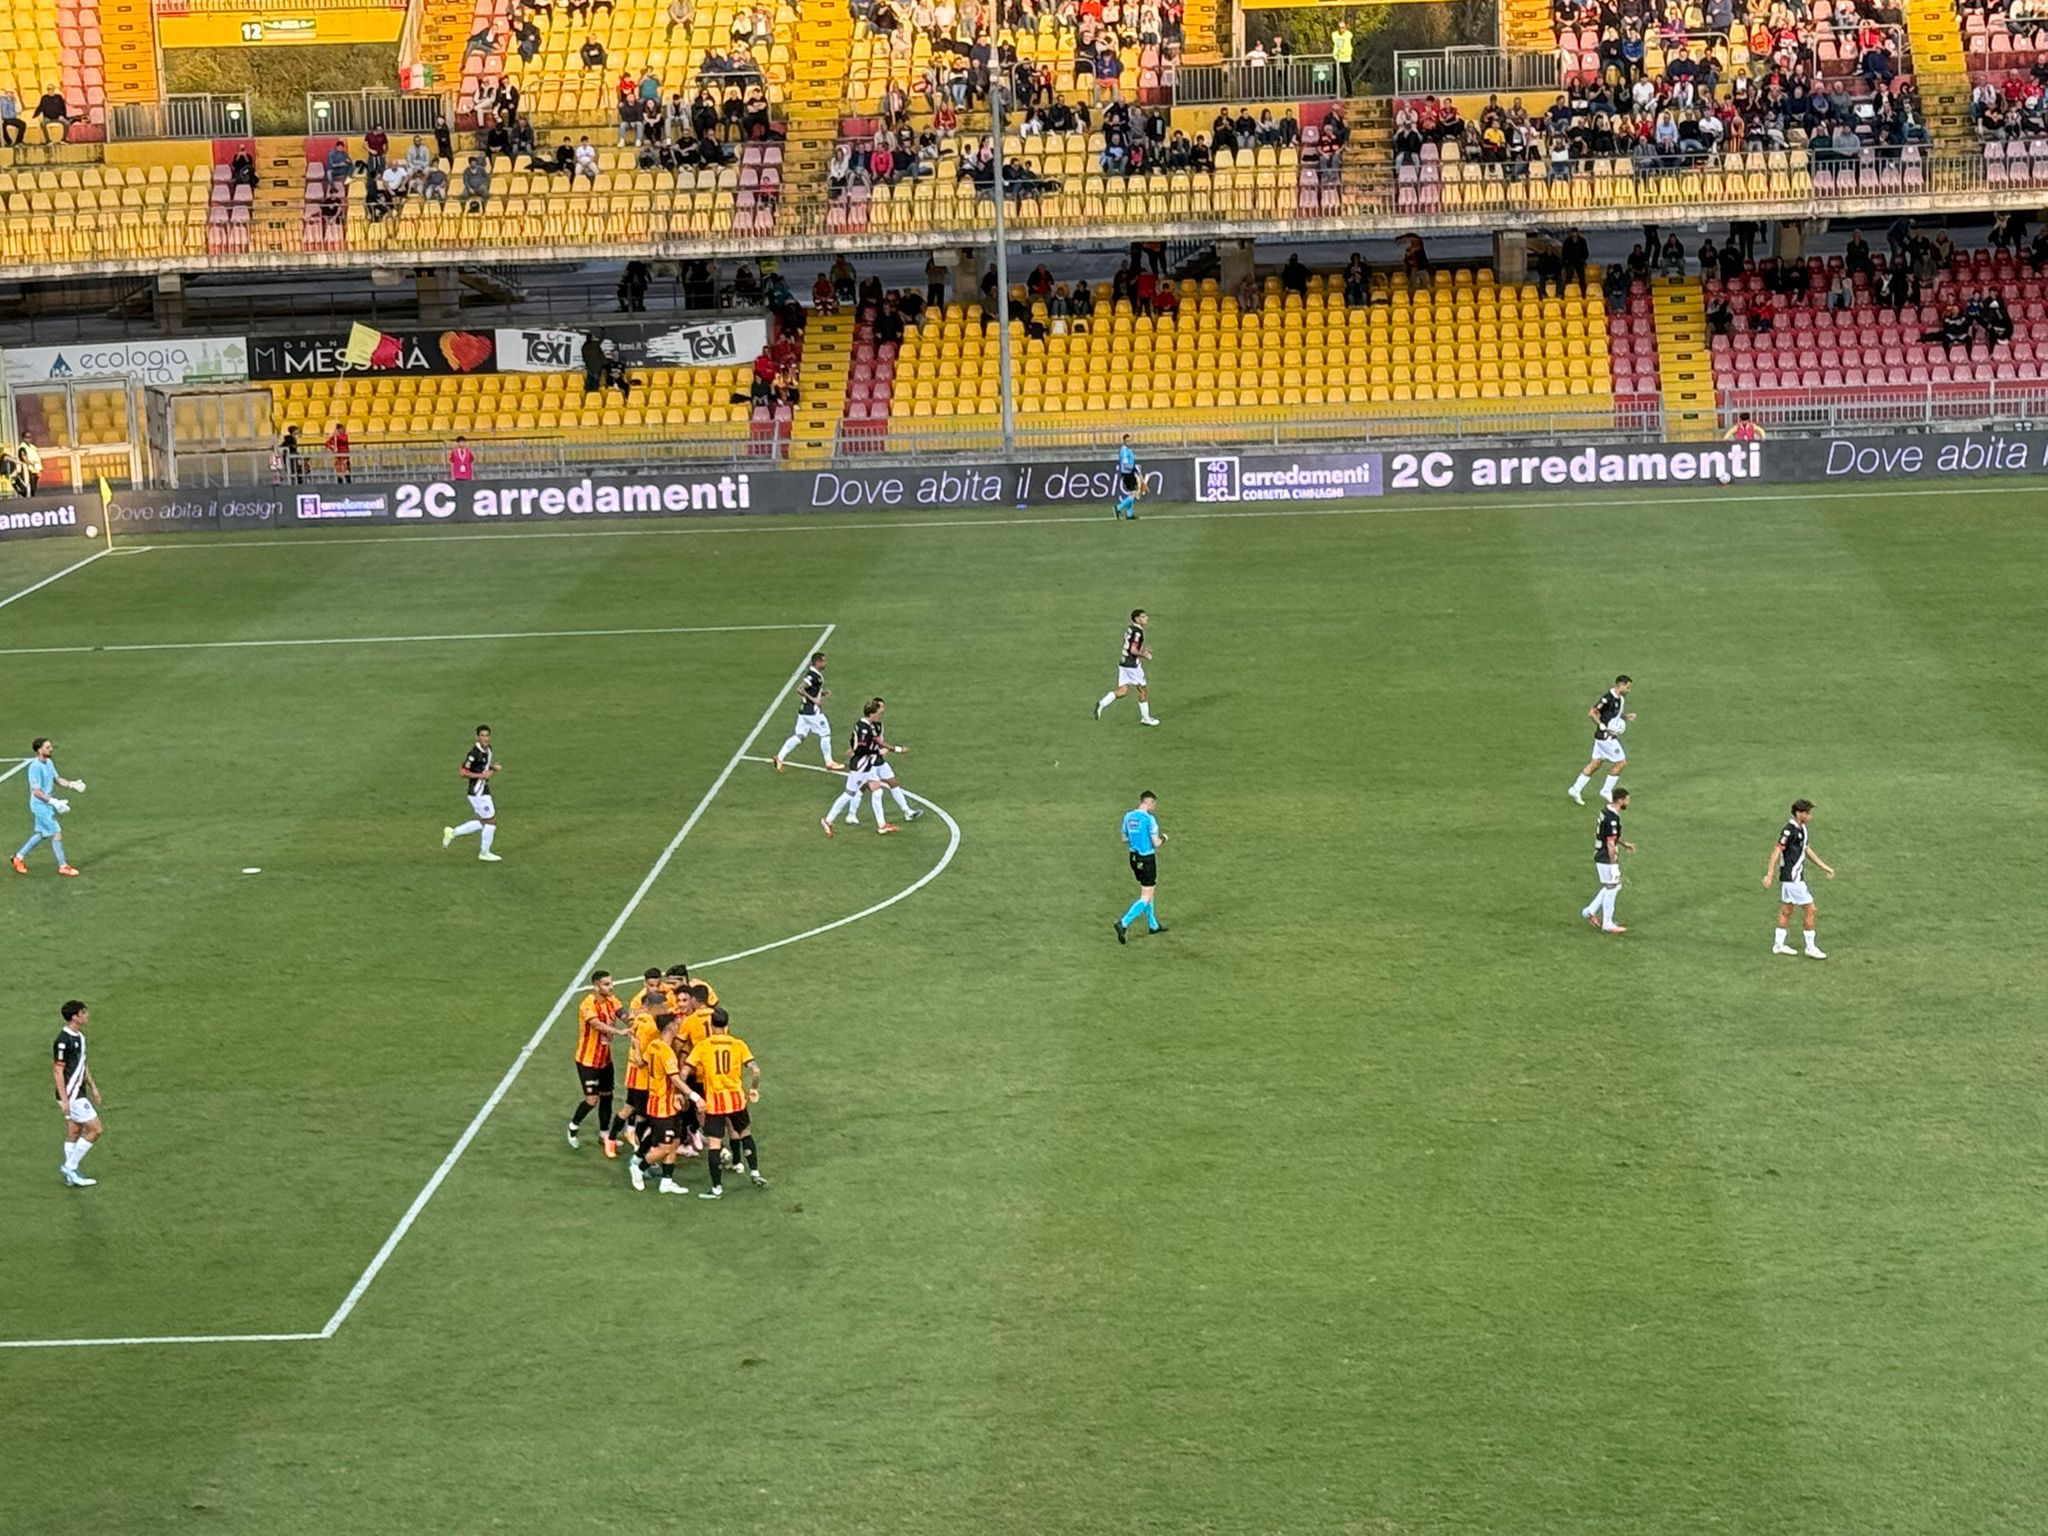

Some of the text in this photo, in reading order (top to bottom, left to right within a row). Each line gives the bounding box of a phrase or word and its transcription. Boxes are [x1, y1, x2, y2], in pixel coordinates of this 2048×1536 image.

[241, 23, 263, 40] 12
[80, 344, 190, 370] ecologia
[1391, 442, 1761, 488] 2C arredamenti
[1826, 440, 1924, 475] Dove
[1937, 435, 2028, 471] abita
[812, 473, 903, 506] Dove
[917, 469, 1001, 503] abita
[1016, 467, 1033, 499] il
[1242, 462, 1370, 486] arredamenti
[396, 474, 750, 519] 2C arredamenti
[108, 503, 154, 522] Dove
[160, 499, 203, 519] abita
[208, 500, 217, 517] il
[222, 499, 284, 520] design
[714, 1049, 731, 1075] 10
